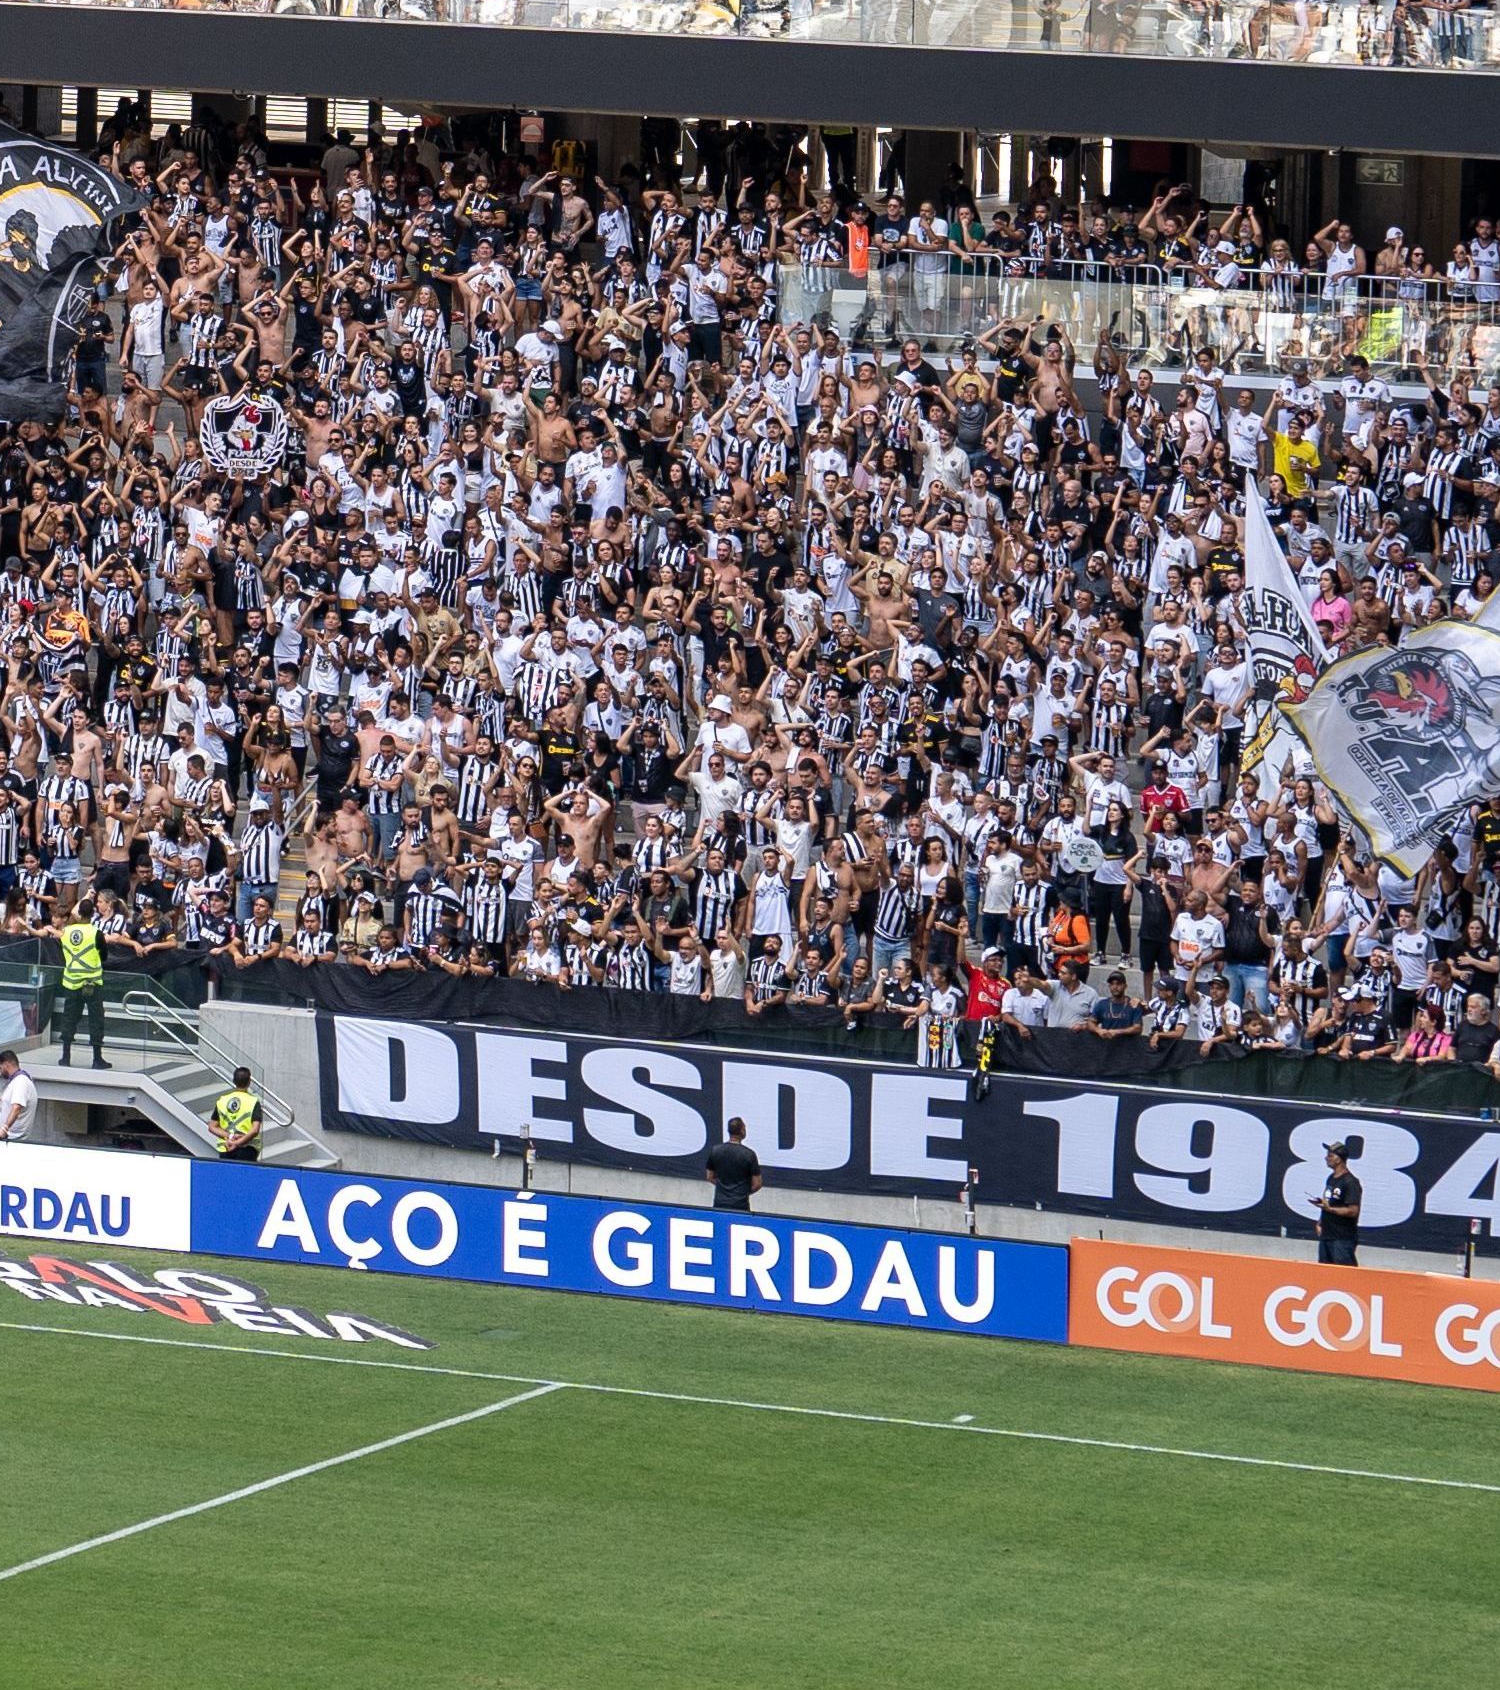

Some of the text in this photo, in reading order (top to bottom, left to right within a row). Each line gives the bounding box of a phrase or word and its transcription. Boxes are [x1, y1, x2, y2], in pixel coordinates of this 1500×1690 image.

[228, 459, 259, 468] DESDE
[334, 1013, 970, 1184] DESDE
[257, 1178, 996, 1325] AÇO É GERDAU
[1096, 1265, 1232, 1339] GOL
[1263, 1284, 1403, 1358] GOL
